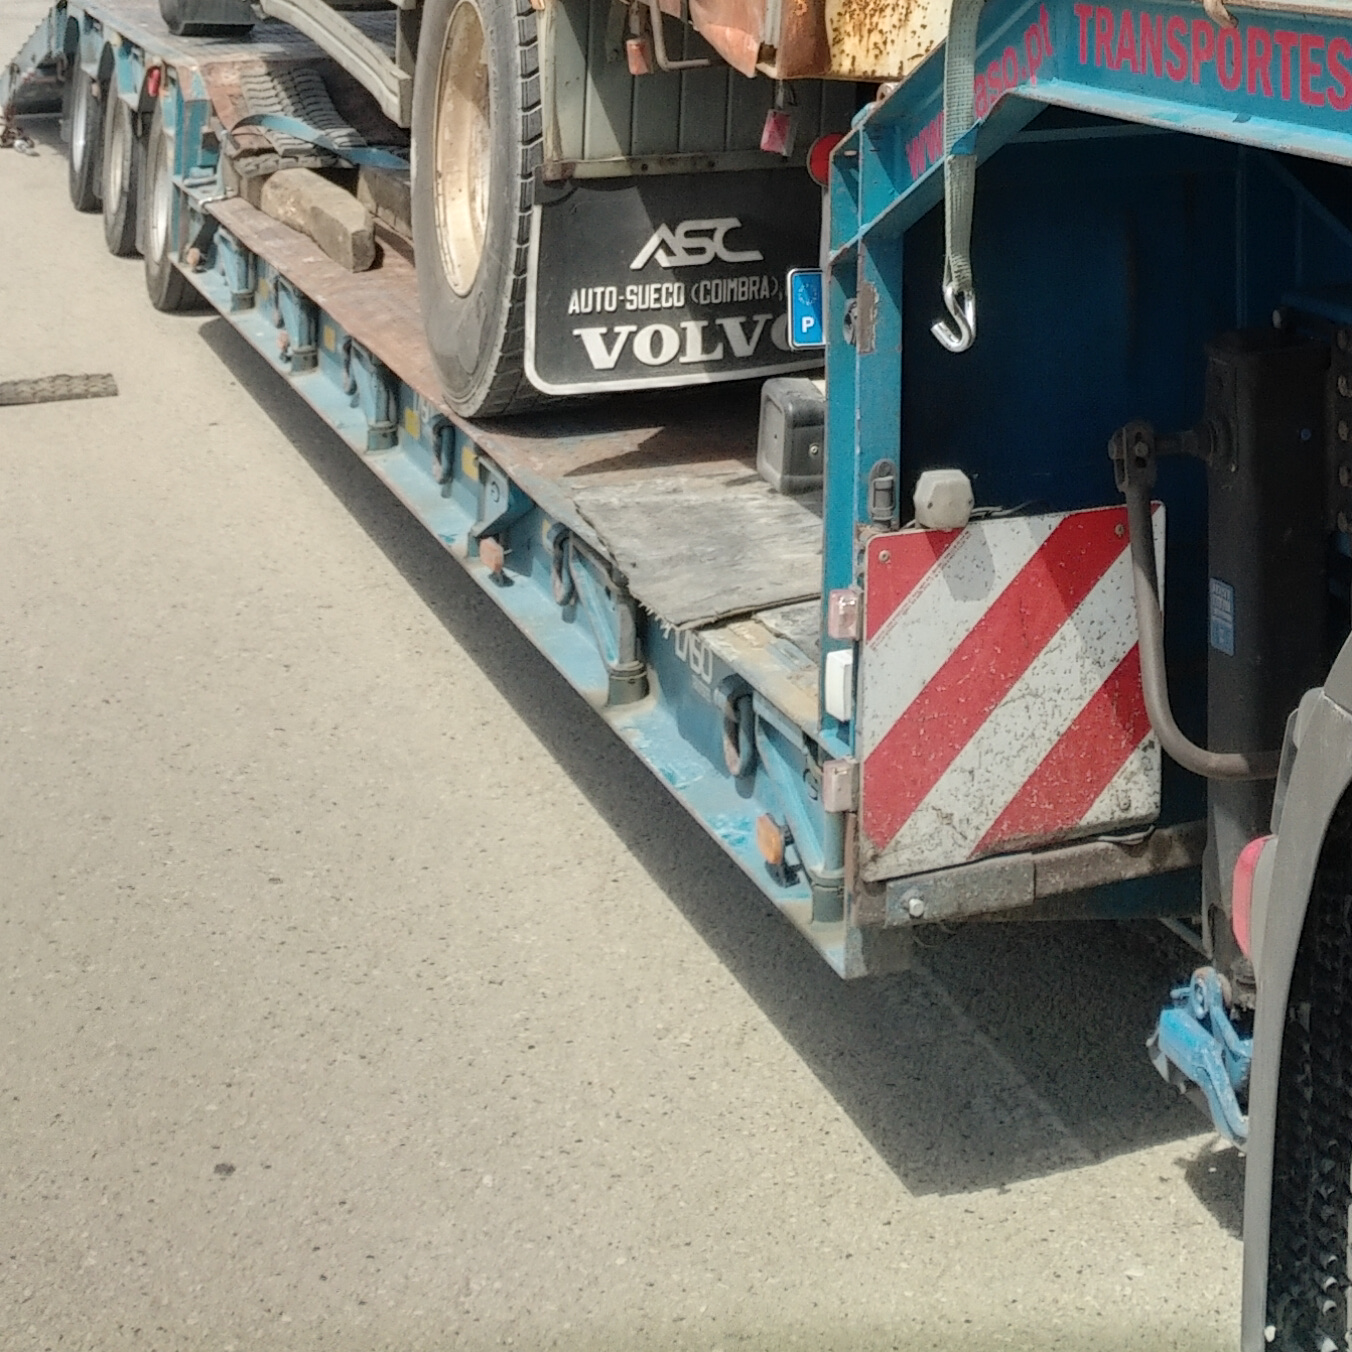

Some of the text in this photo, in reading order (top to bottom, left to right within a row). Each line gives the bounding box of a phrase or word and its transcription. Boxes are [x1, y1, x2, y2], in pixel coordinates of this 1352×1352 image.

[629, 217, 765, 270] ASC
[568, 282, 685, 315] AUTO-SUECO
[801, 316, 815, 333] P
